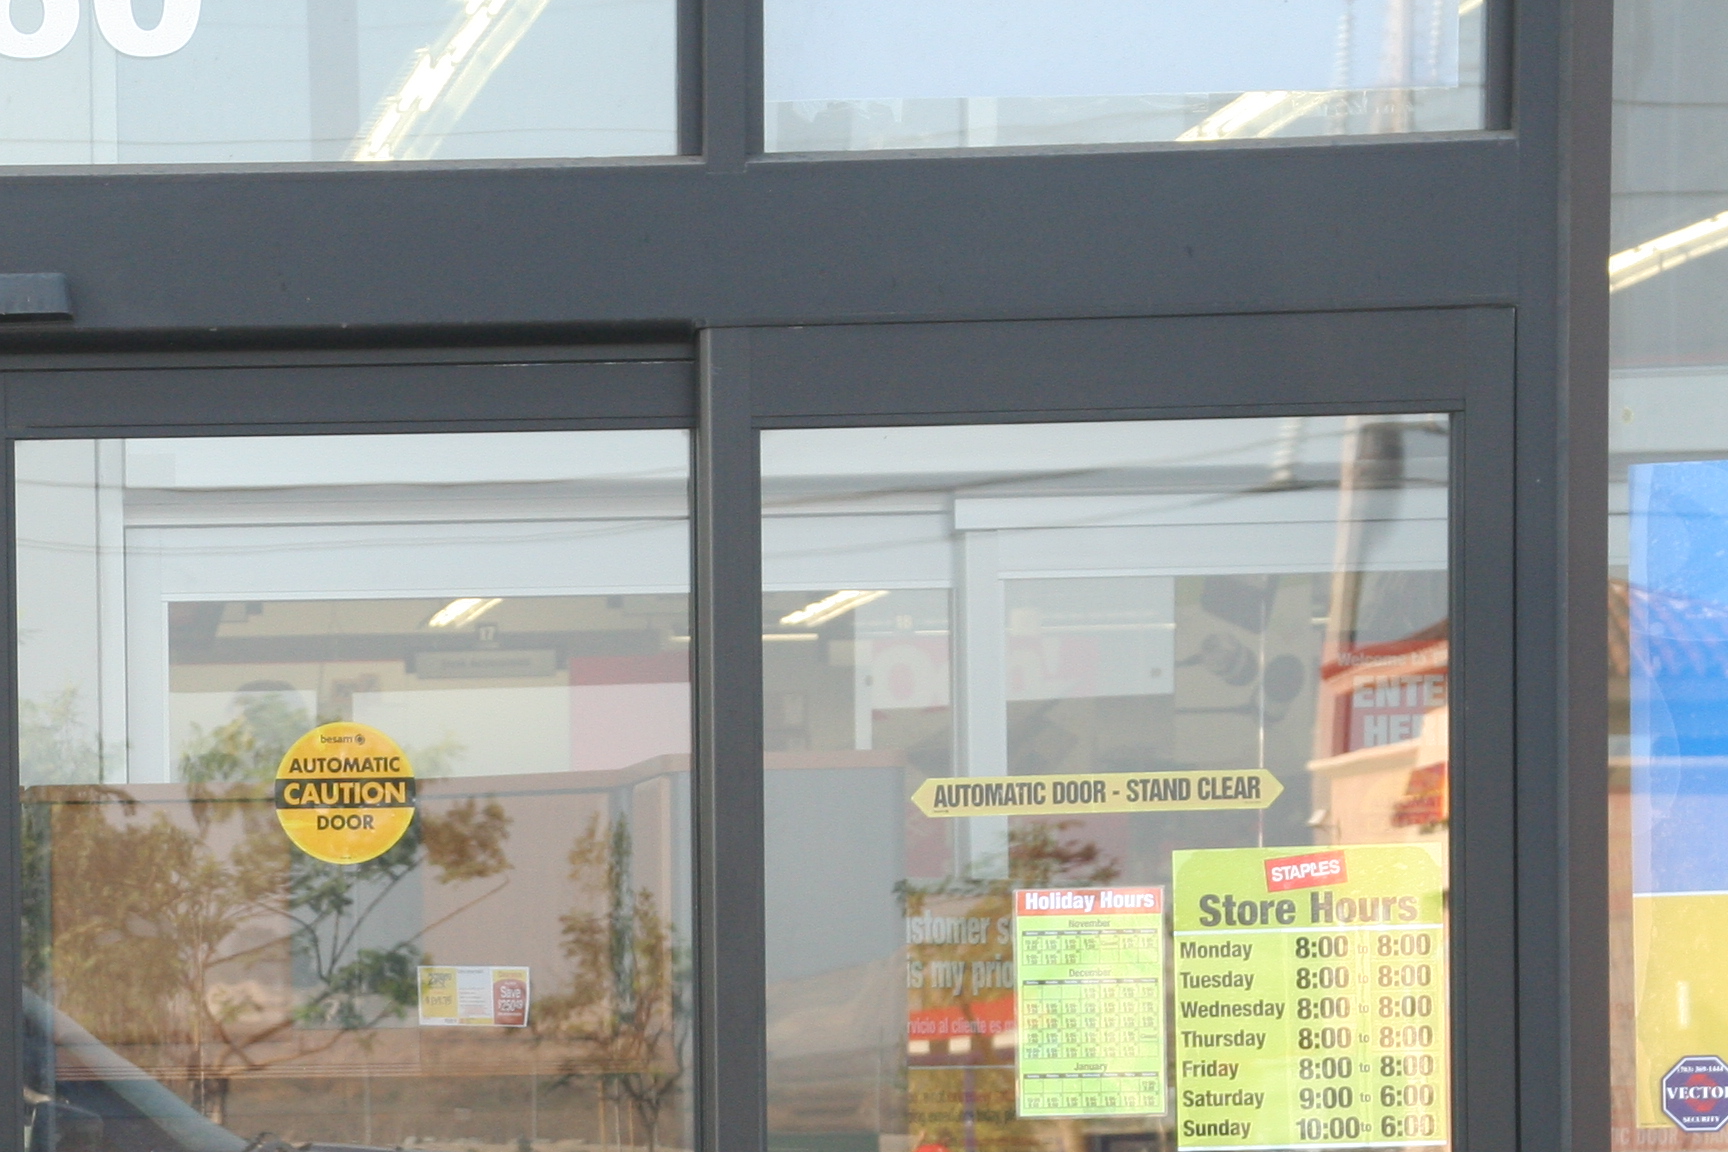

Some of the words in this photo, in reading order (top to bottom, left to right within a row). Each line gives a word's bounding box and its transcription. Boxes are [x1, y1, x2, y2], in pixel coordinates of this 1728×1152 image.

[1352, 675, 1446, 707] ENTE
[320, 735, 353, 744] besam
[289, 757, 400, 773] AUTOMATIC
[284, 781, 406, 805] CAUTION
[933, 782, 1046, 808] AUTOMATIC
[1053, 781, 1106, 805] DOOR
[1126, 778, 1191, 803] STAND
[1197, 776, 1261, 800] CLEAR
[317, 815, 374, 830] DOOR
[1271, 859, 1341, 882] STAPLES
[1025, 891, 1095, 912] Holiday
[1100, 890, 1155, 908] Hours
[1199, 893, 1296, 927] Store
[1310, 891, 1418, 924] Hours
[1069, 919, 1111, 928] November
[1180, 941, 1253, 961] Monday
[1295, 935, 1349, 959] 8:00
[1357, 943, 1369, 955] to
[1377, 933, 1431, 957] 8:00
[907, 954, 924, 988] is
[930, 961, 965, 997] my
[972, 954, 1014, 996] prio
[1069, 968, 1111, 977] December
[1179, 970, 1255, 991] Tuesday
[1296, 966, 1350, 989] 8:00
[1357, 973, 1369, 985] to
[1377, 964, 1432, 988] 8:00
[500, 986, 521, 998] Save
[1180, 999, 1286, 1020] Wednesday
[1297, 996, 1351, 1020] 8:00
[1358, 1002, 1370, 1015] to
[1378, 994, 1432, 1018] 8:00
[907, 1017, 936, 1034] rvicio
[1181, 1030, 1266, 1050] Thursday
[1298, 1027, 1352, 1050] 8:00
[1358, 1032, 1370, 1043] to
[1379, 1025, 1433, 1048] 8:00
[1074, 1062, 1108, 1073] January
[1182, 1059, 1239, 1080] Friday
[1299, 1056, 1352, 1080] 8:00
[1359, 1062, 1370, 1073] to
[1380, 1054, 1434, 1077] 8:00
[1182, 1089, 1265, 1109] Saturday
[1299, 1086, 1353, 1109] 9:00
[1360, 1092, 1371, 1102] to
[1380, 1084, 1434, 1107] 6:00
[1183, 1119, 1251, 1139] Sunday
[1296, 1116, 1360, 1140] 10:00
[1360, 1122, 1372, 1133] to
[1381, 1114, 1435, 1137] 6:00
[1683, 1115, 1720, 1123] SECURITY
